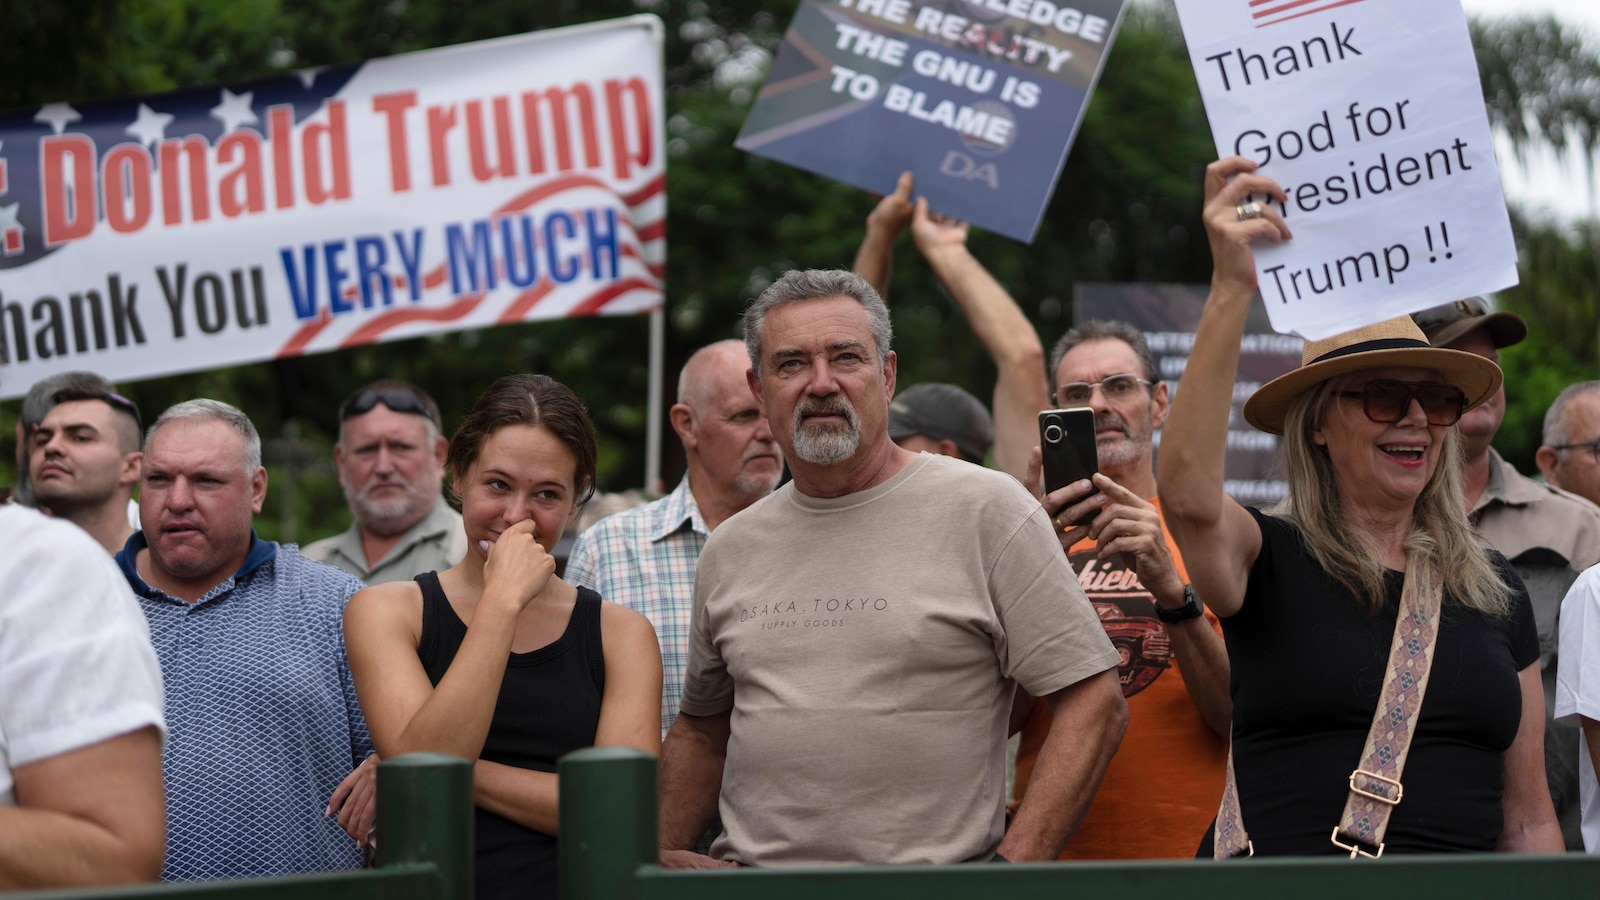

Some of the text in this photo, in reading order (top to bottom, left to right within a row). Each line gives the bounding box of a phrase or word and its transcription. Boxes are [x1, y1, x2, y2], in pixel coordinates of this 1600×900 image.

[835, 23, 1042, 108] THE GNU IS
[914, 6, 1073, 72] REALITY
[1205, 22, 1362, 91] Thank
[831, 66, 1014, 146] TO BLAME
[1234, 99, 1409, 168] God for
[41, 100, 351, 246] Donald
[373, 75, 651, 193] Trump
[939, 150, 998, 190] DA
[1247, 138, 1472, 217] resident
[0, 208, 620, 365] hank You VERY MUCH
[1263, 221, 1453, 304] Trump !!
[760, 619, 845, 630] SUPPLY GOODS
